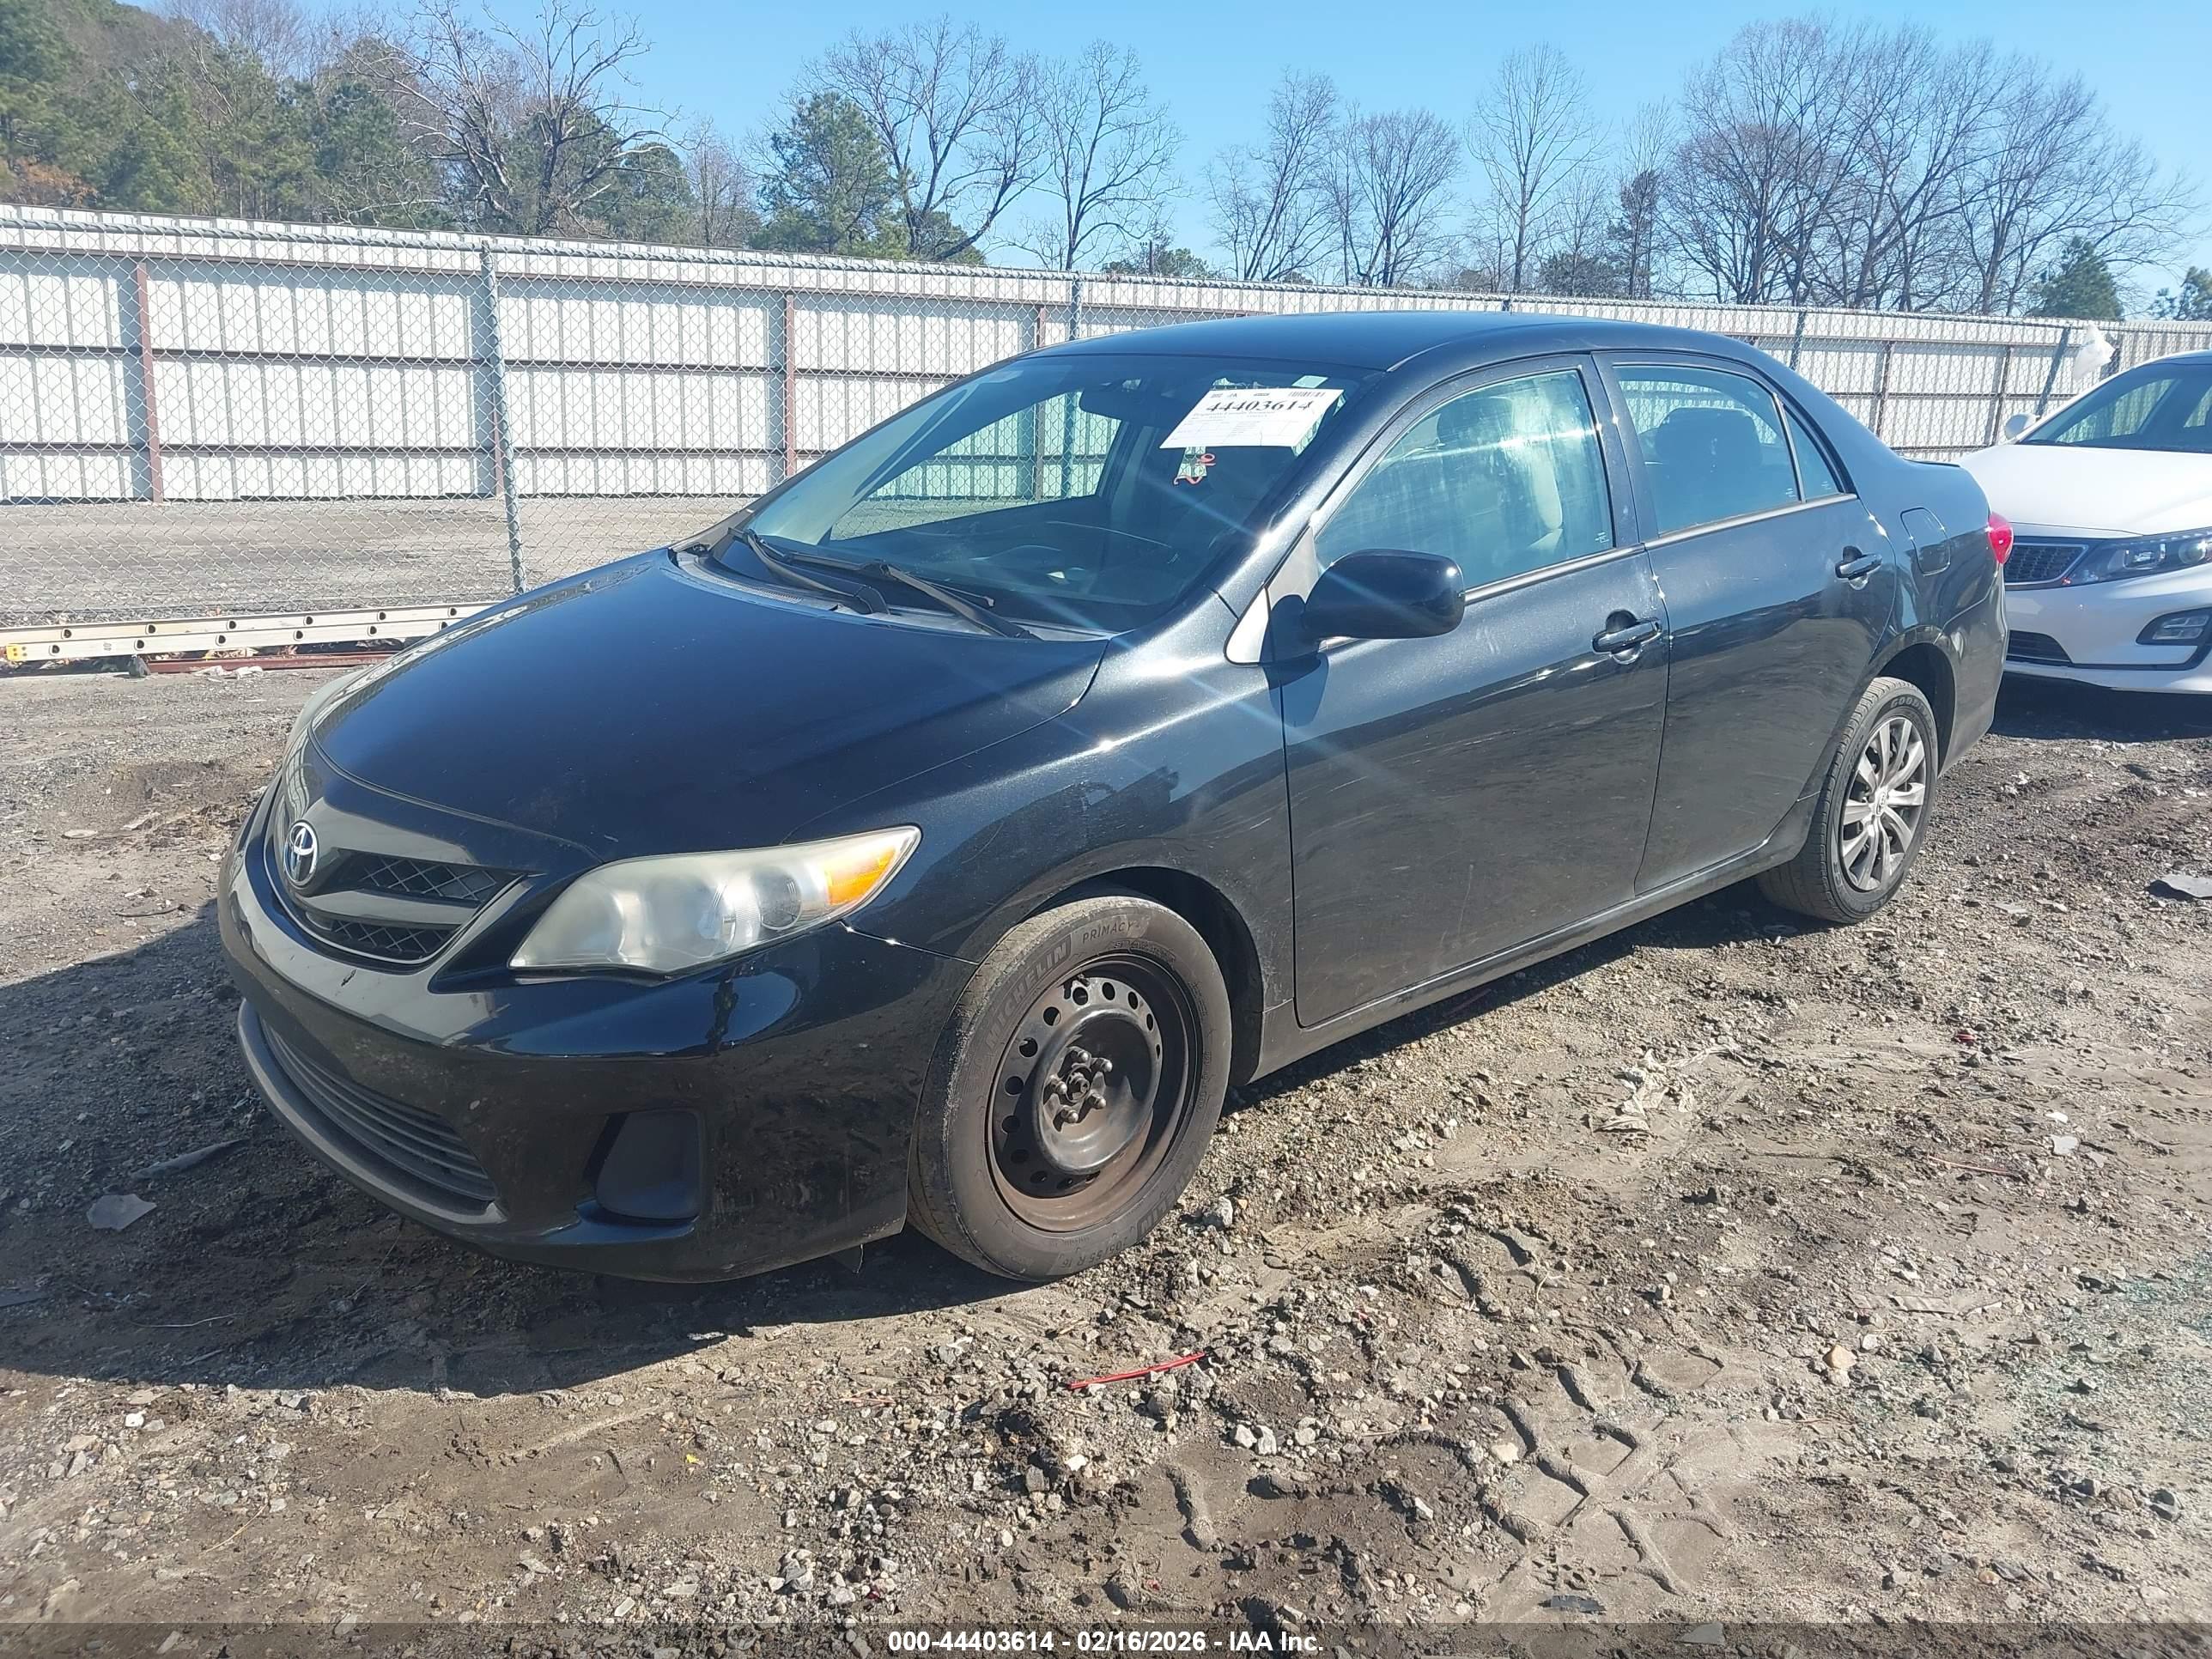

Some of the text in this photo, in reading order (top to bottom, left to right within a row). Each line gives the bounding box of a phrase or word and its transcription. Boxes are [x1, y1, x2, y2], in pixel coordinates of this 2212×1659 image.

[1206, 400, 1315, 412] 44403614
[985, 921, 1134, 1050] MICHELIN PRIMACY
